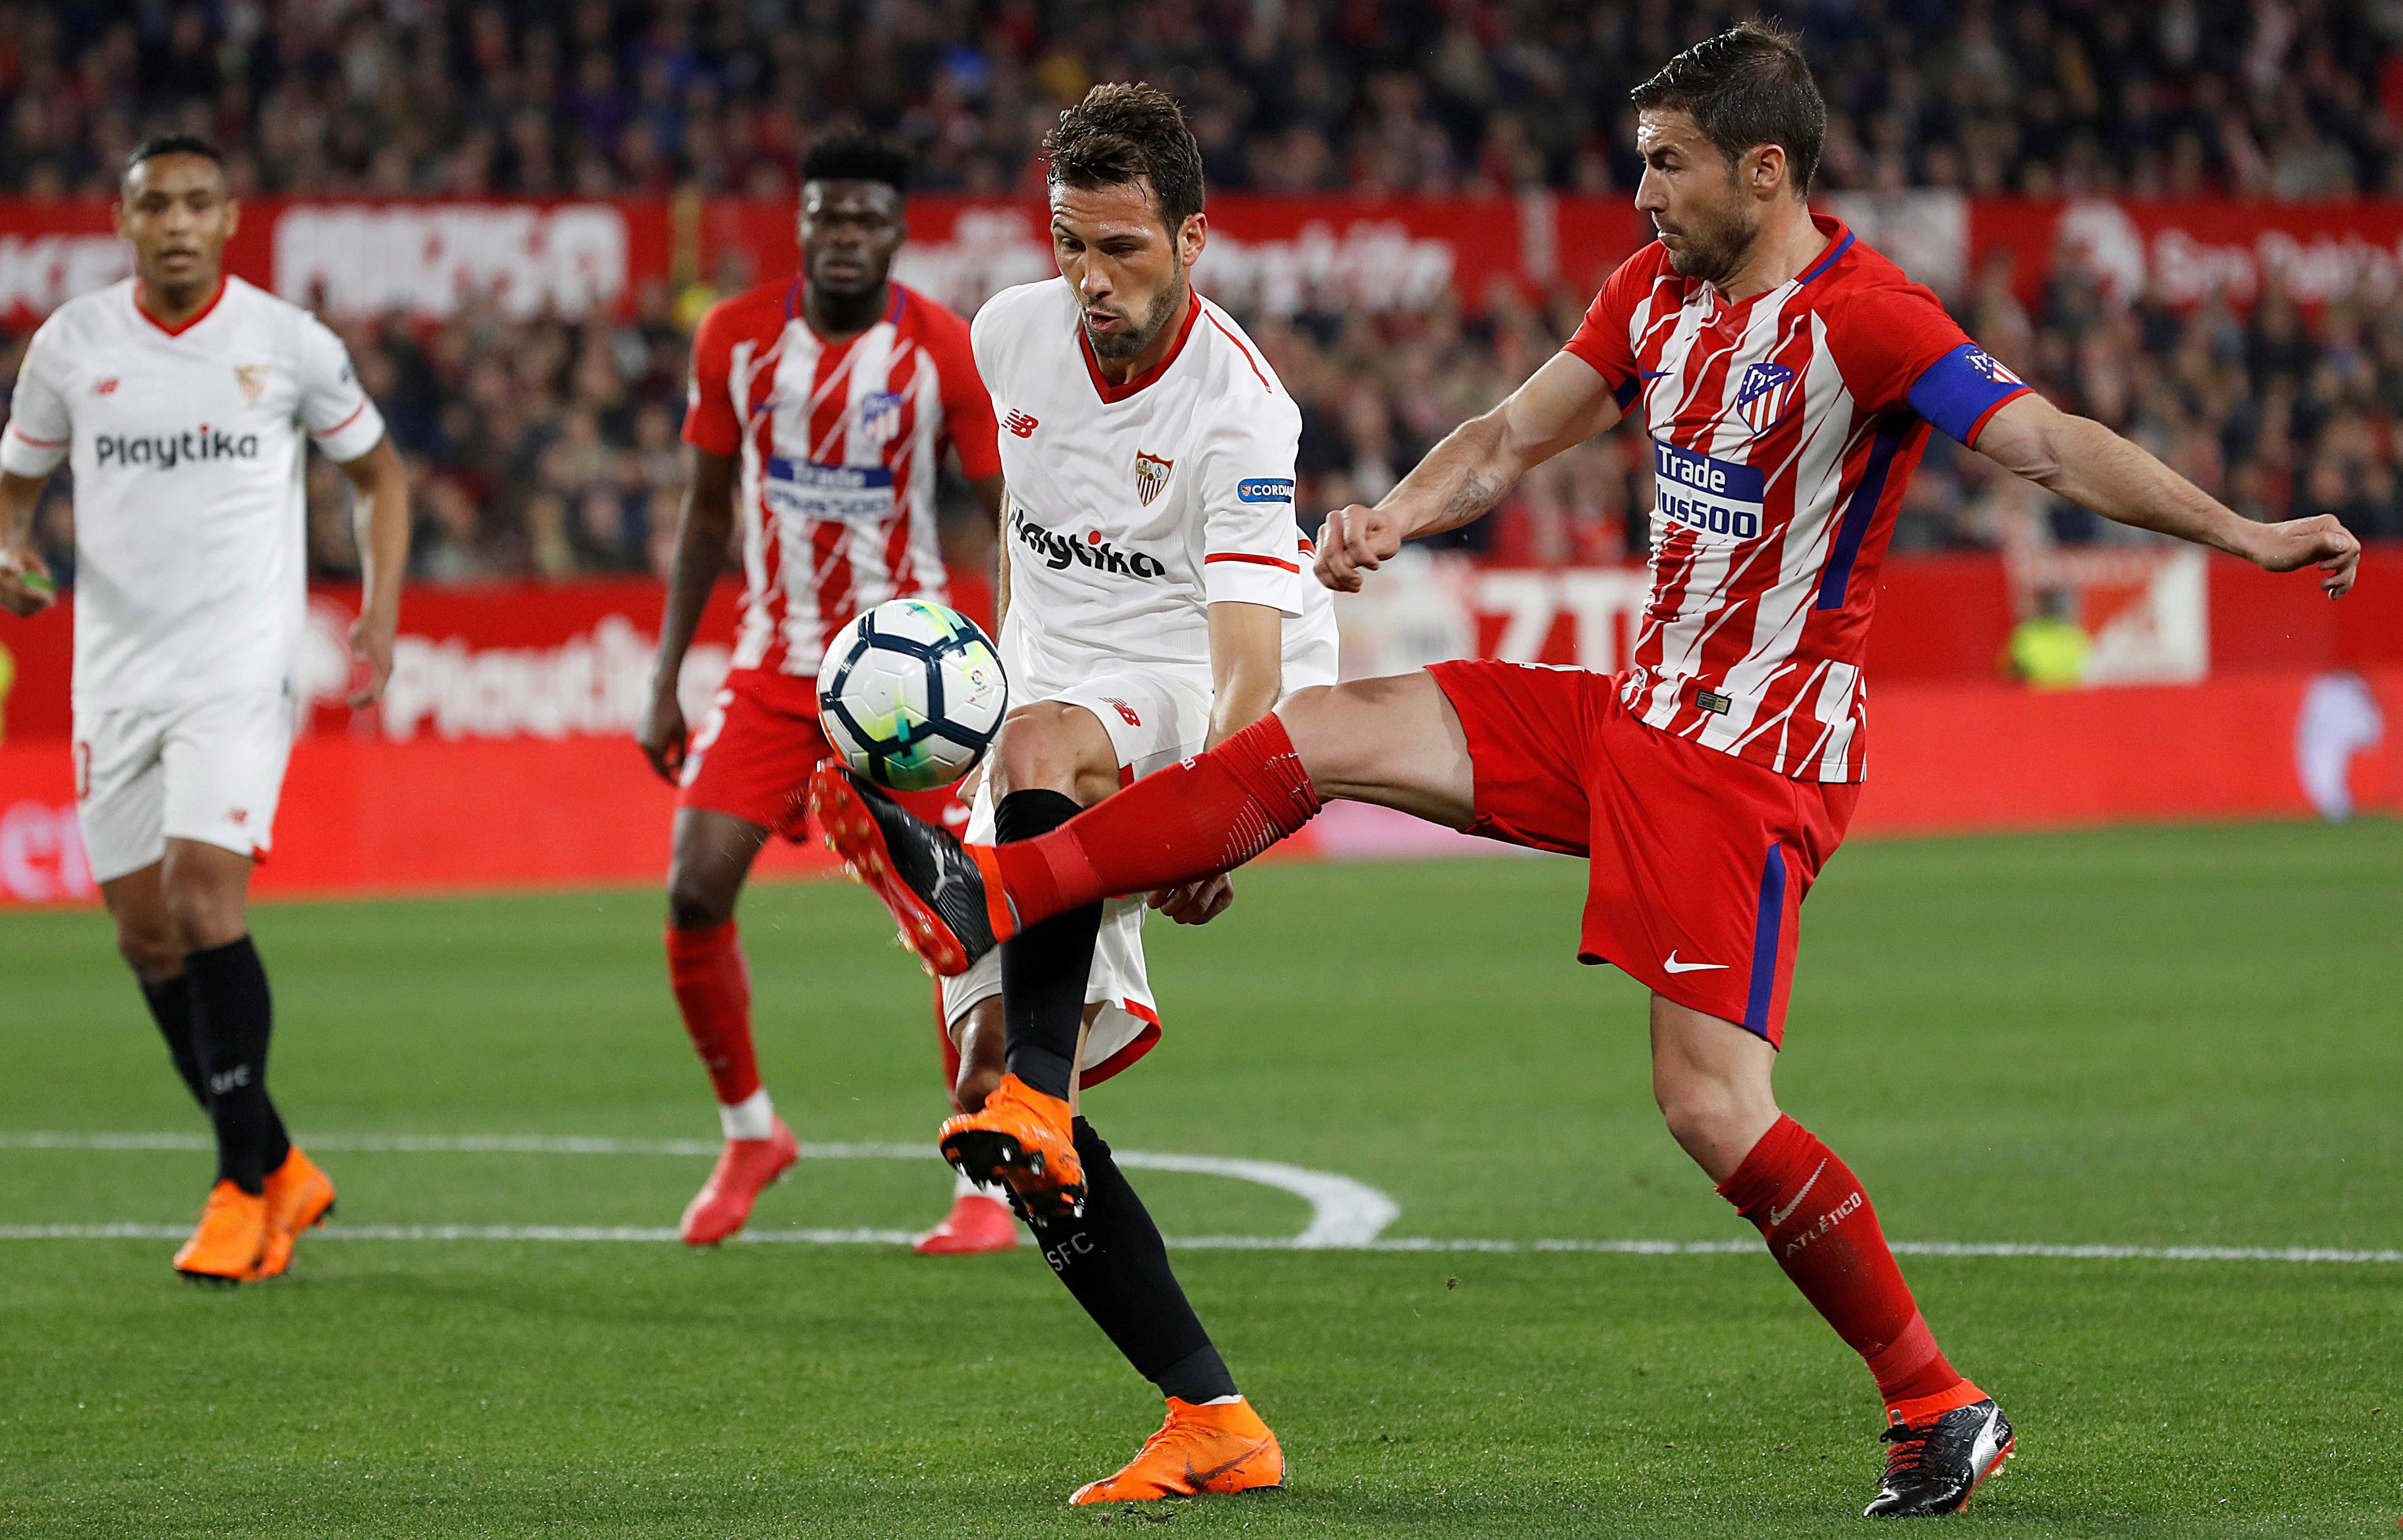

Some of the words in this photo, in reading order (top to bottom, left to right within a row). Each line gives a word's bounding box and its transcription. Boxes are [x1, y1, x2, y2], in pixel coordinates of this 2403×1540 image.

[95, 423, 258, 470] Playtika
[1658, 444, 1725, 493] Trade
[1009, 508, 1166, 578] laytika
[1786, 1191, 1863, 1258] ATLÉTICO
[1046, 1232, 1094, 1272] SFC
